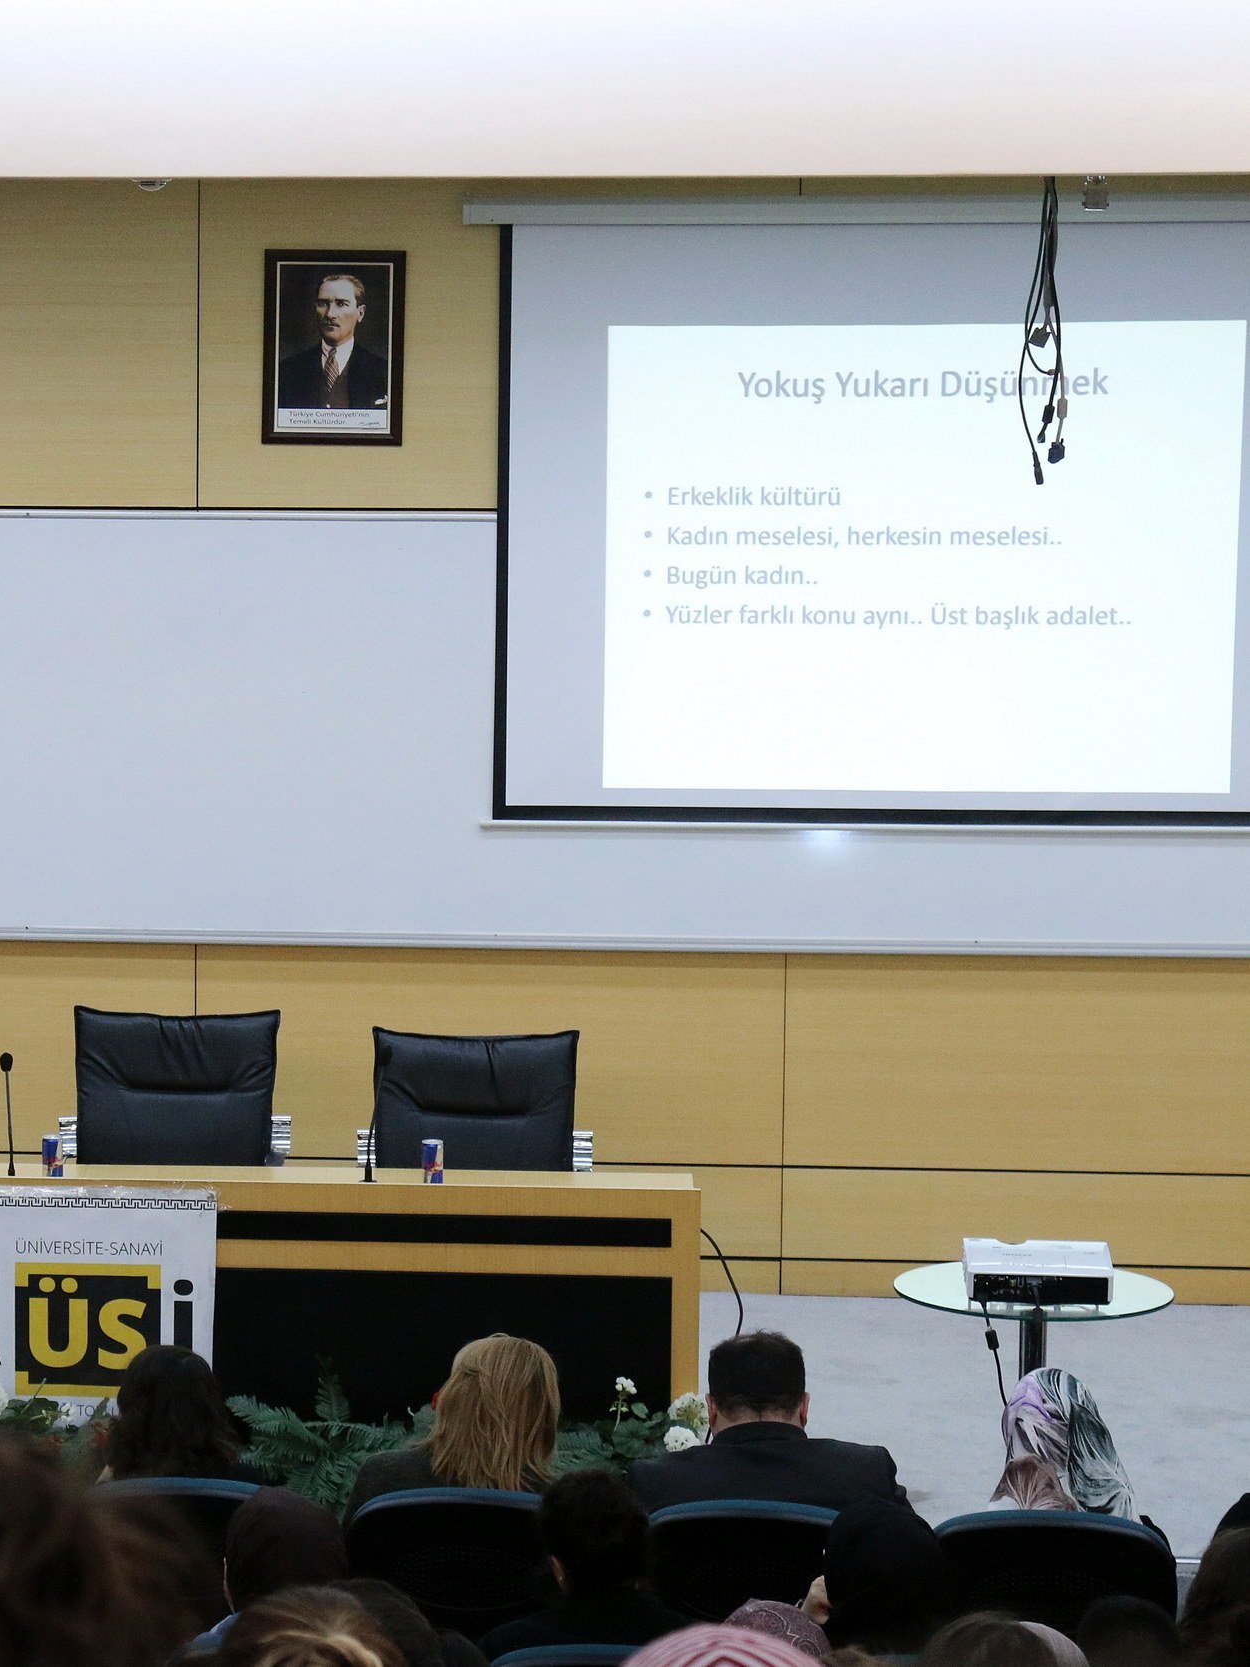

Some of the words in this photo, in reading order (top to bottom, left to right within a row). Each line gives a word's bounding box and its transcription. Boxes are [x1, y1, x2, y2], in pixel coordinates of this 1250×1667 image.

[737, 369, 826, 404] Yokuş
[835, 369, 929, 398] Yukarı
[940, 367, 1109, 404] Düşünmek
[667, 486, 754, 506] Erkeklik
[760, 486, 841, 506] kültürü
[667, 526, 728, 546] Kadın
[736, 526, 840, 549] meselesi,
[847, 526, 942, 546] herkesin
[950, 525, 1062, 546] meselesi..
[667, 566, 736, 590] Bugün
[745, 566, 818, 585] kadın..
[666, 605, 733, 625] Yüzler
[739, 605, 793, 625] farklı
[802, 605, 856, 625] konu
[863, 608, 922, 630] aynı..
[931, 602, 969, 625] Üst
[975, 604, 1040, 630] başlık
[1046, 605, 1132, 626] adalet..
[14, 1237, 164, 1257] ÜNİVERSİTE-SANAYİ
